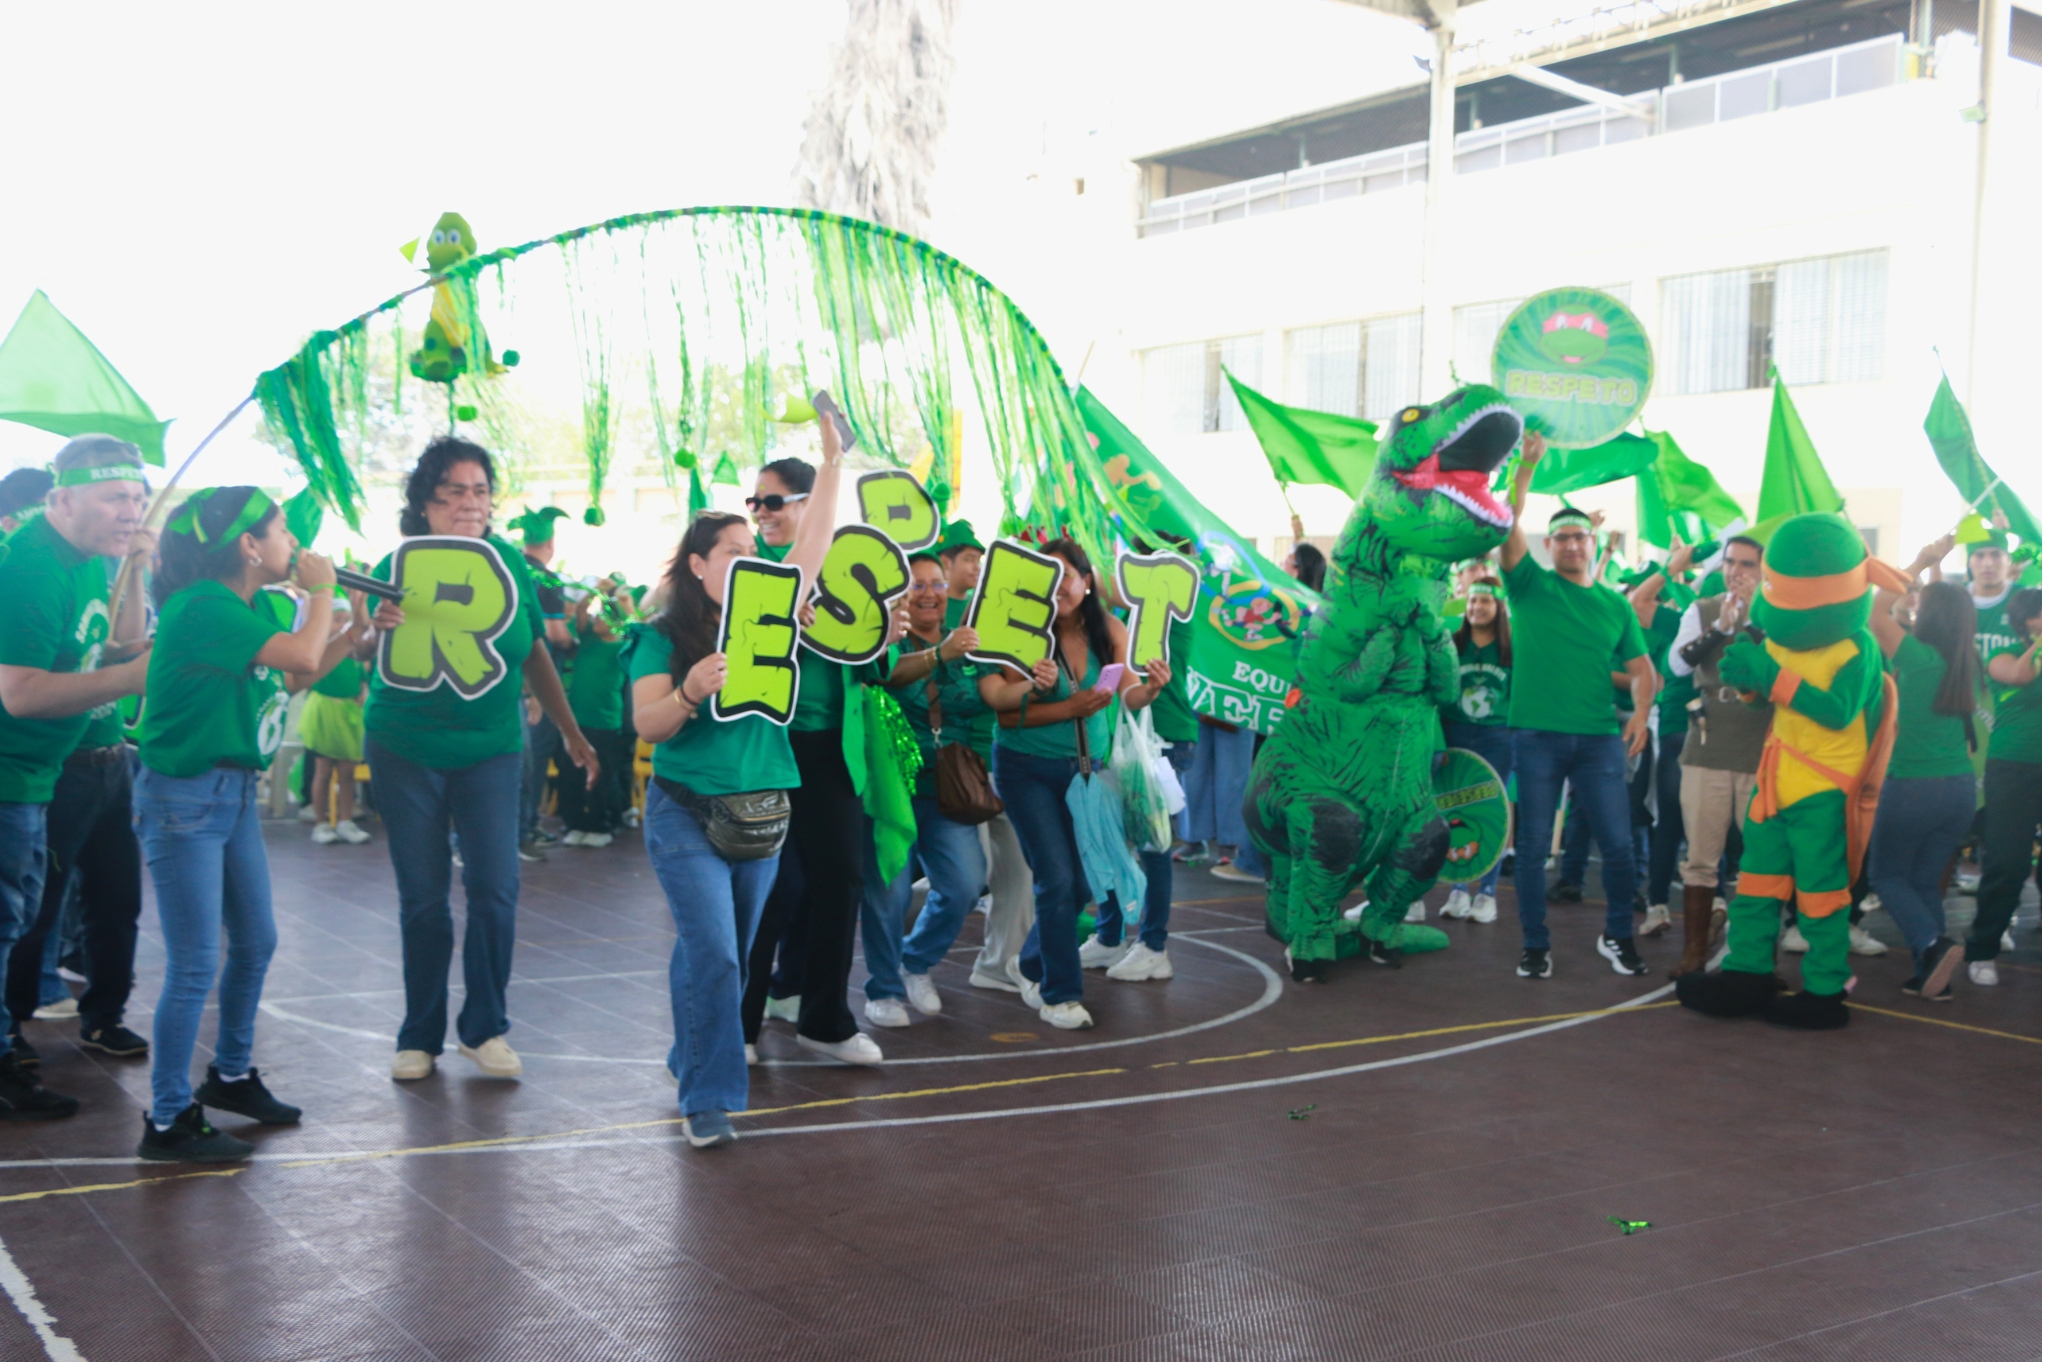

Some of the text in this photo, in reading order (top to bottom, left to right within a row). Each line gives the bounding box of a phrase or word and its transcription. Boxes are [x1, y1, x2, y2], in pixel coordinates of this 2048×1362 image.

[1507, 370, 1636, 405] RESPETO
[381, 539, 516, 697] R
[714, 558, 801, 723] E
[801, 526, 910, 662] S
[968, 540, 1062, 680] E
[1118, 551, 1197, 674] T
